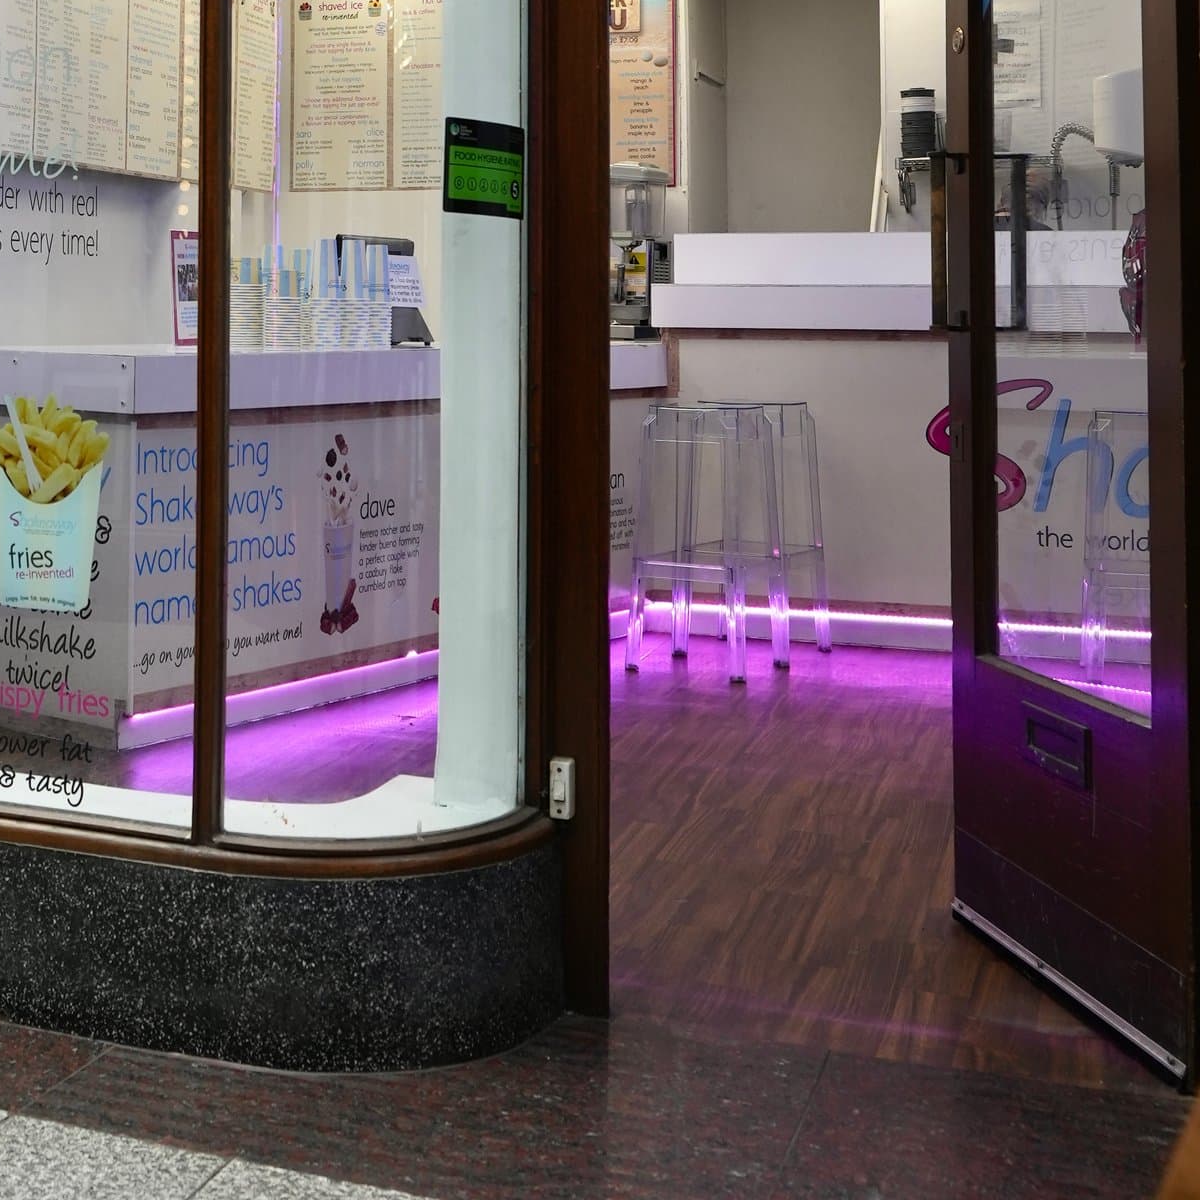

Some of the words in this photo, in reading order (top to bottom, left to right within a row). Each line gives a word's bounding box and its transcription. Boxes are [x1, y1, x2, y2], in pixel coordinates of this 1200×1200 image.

[318, 1, 348, 11] shaved
[350, 1, 363, 10] ice
[454, 150, 477, 161] FOOD
[28, 180, 64, 215] with
[71, 185, 98, 217] real
[511, 181, 519, 199] 5
[10, 230, 54, 266] every
[61, 229, 99, 257] time!
[359, 492, 396, 520] dave
[1036, 525, 1073, 549] the
[8, 543, 54, 569] fries
[15, 565, 75, 580] re-invented!
[232, 570, 302, 613] shakes
[255, 630, 280, 646] want
[283, 622, 303, 640] one!
[5, 660, 70, 695] twice!
[57, 680, 110, 718] fries
[59, 734, 93, 764] fat
[25, 769, 84, 808] tasty
